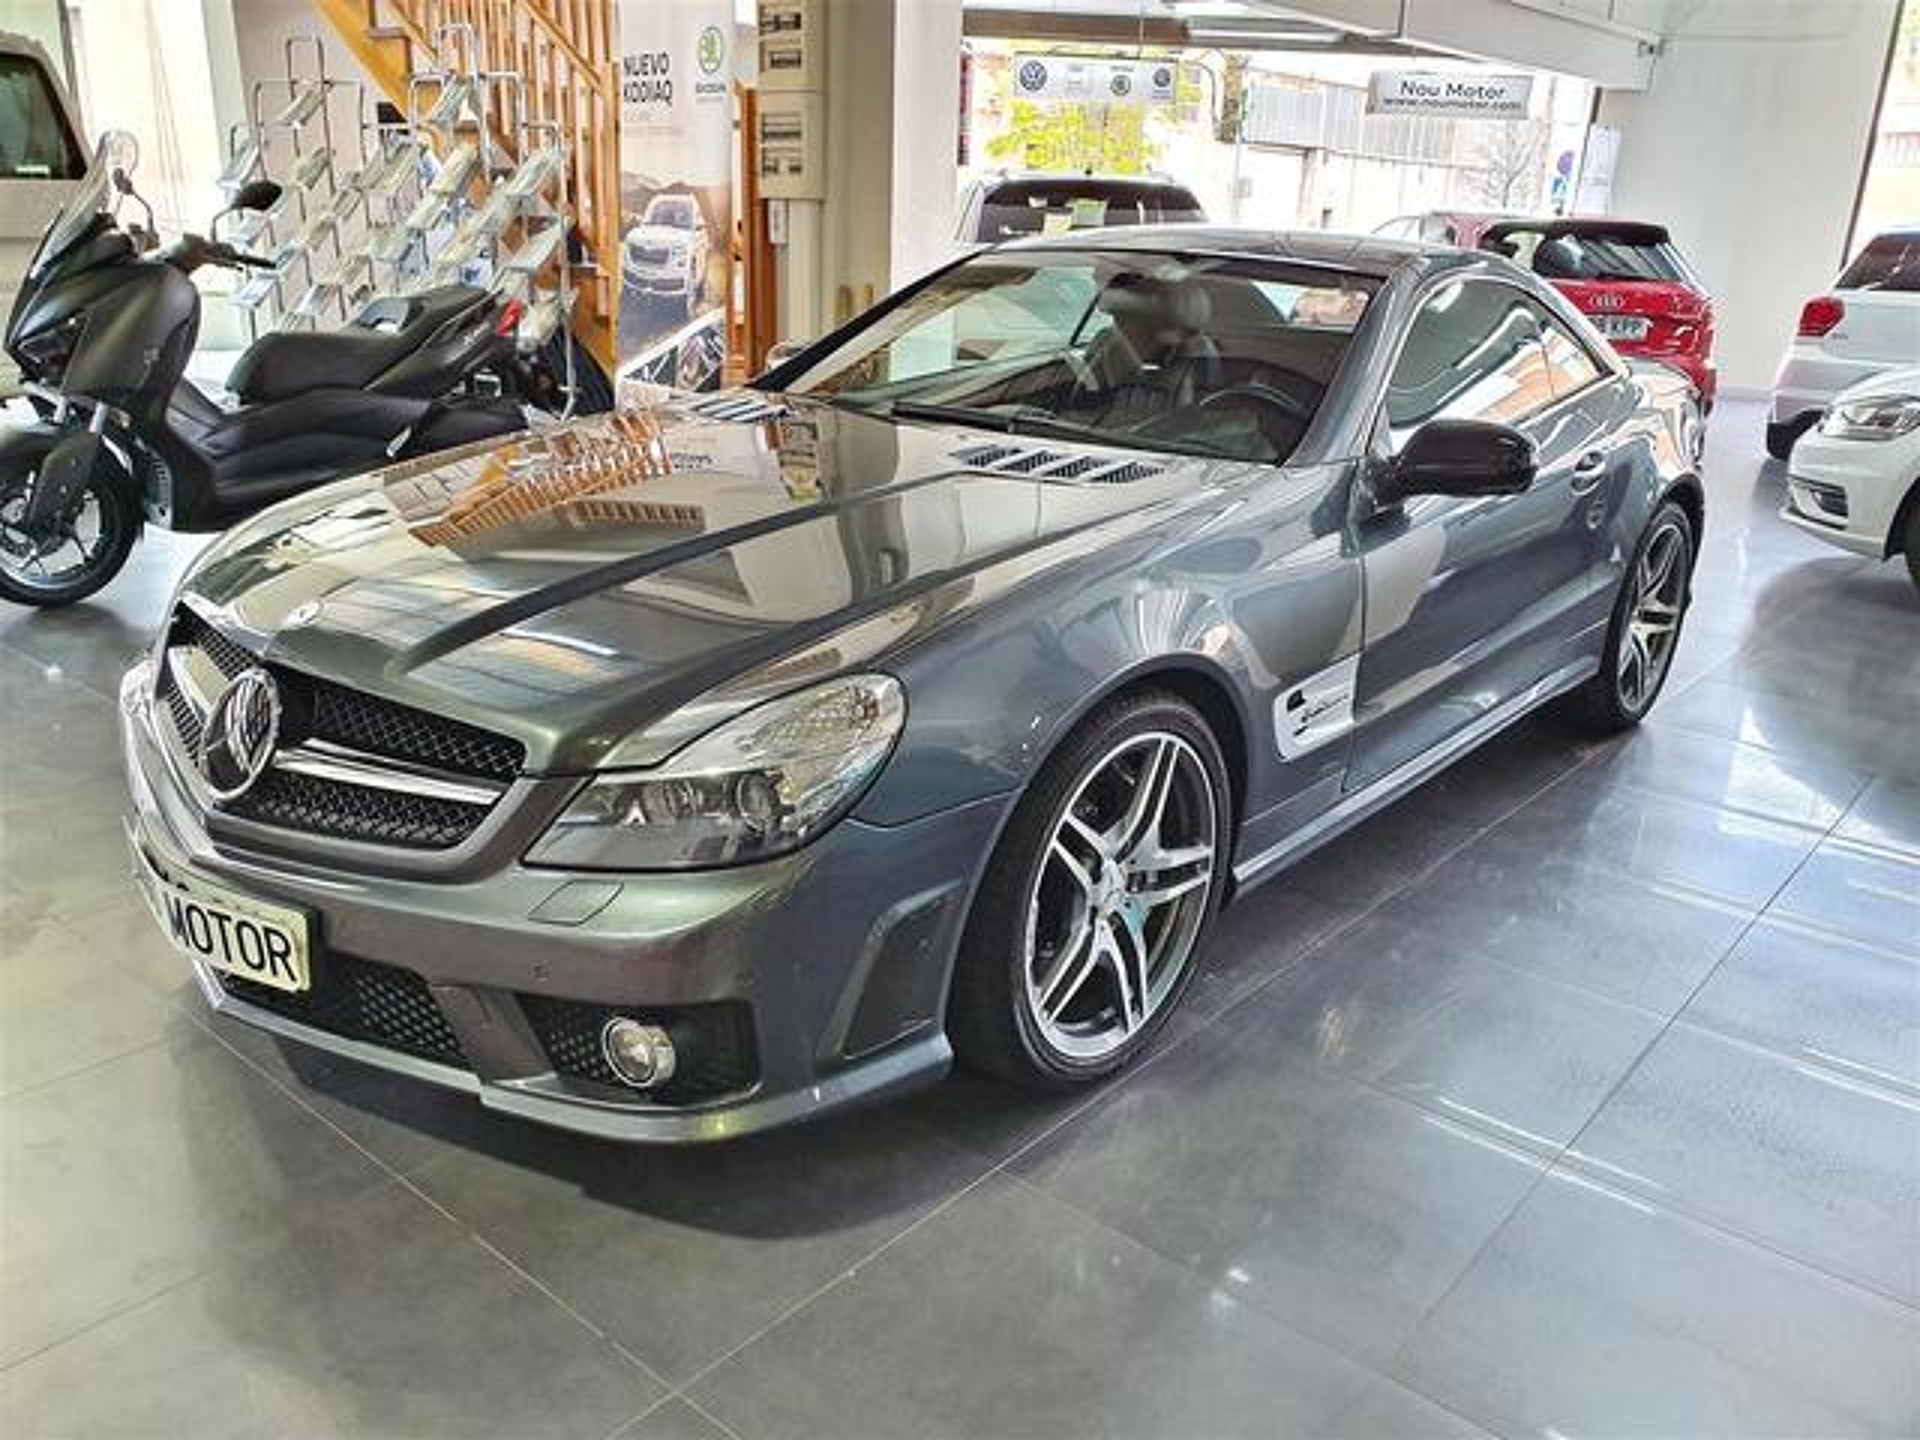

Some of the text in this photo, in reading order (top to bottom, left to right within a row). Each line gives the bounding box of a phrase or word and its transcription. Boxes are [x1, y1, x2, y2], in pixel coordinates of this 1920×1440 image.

[623, 51, 670, 75] NUEVO
[1400, 80, 1505, 99] Nou Motor
[163, 892, 297, 983] MOTOR
